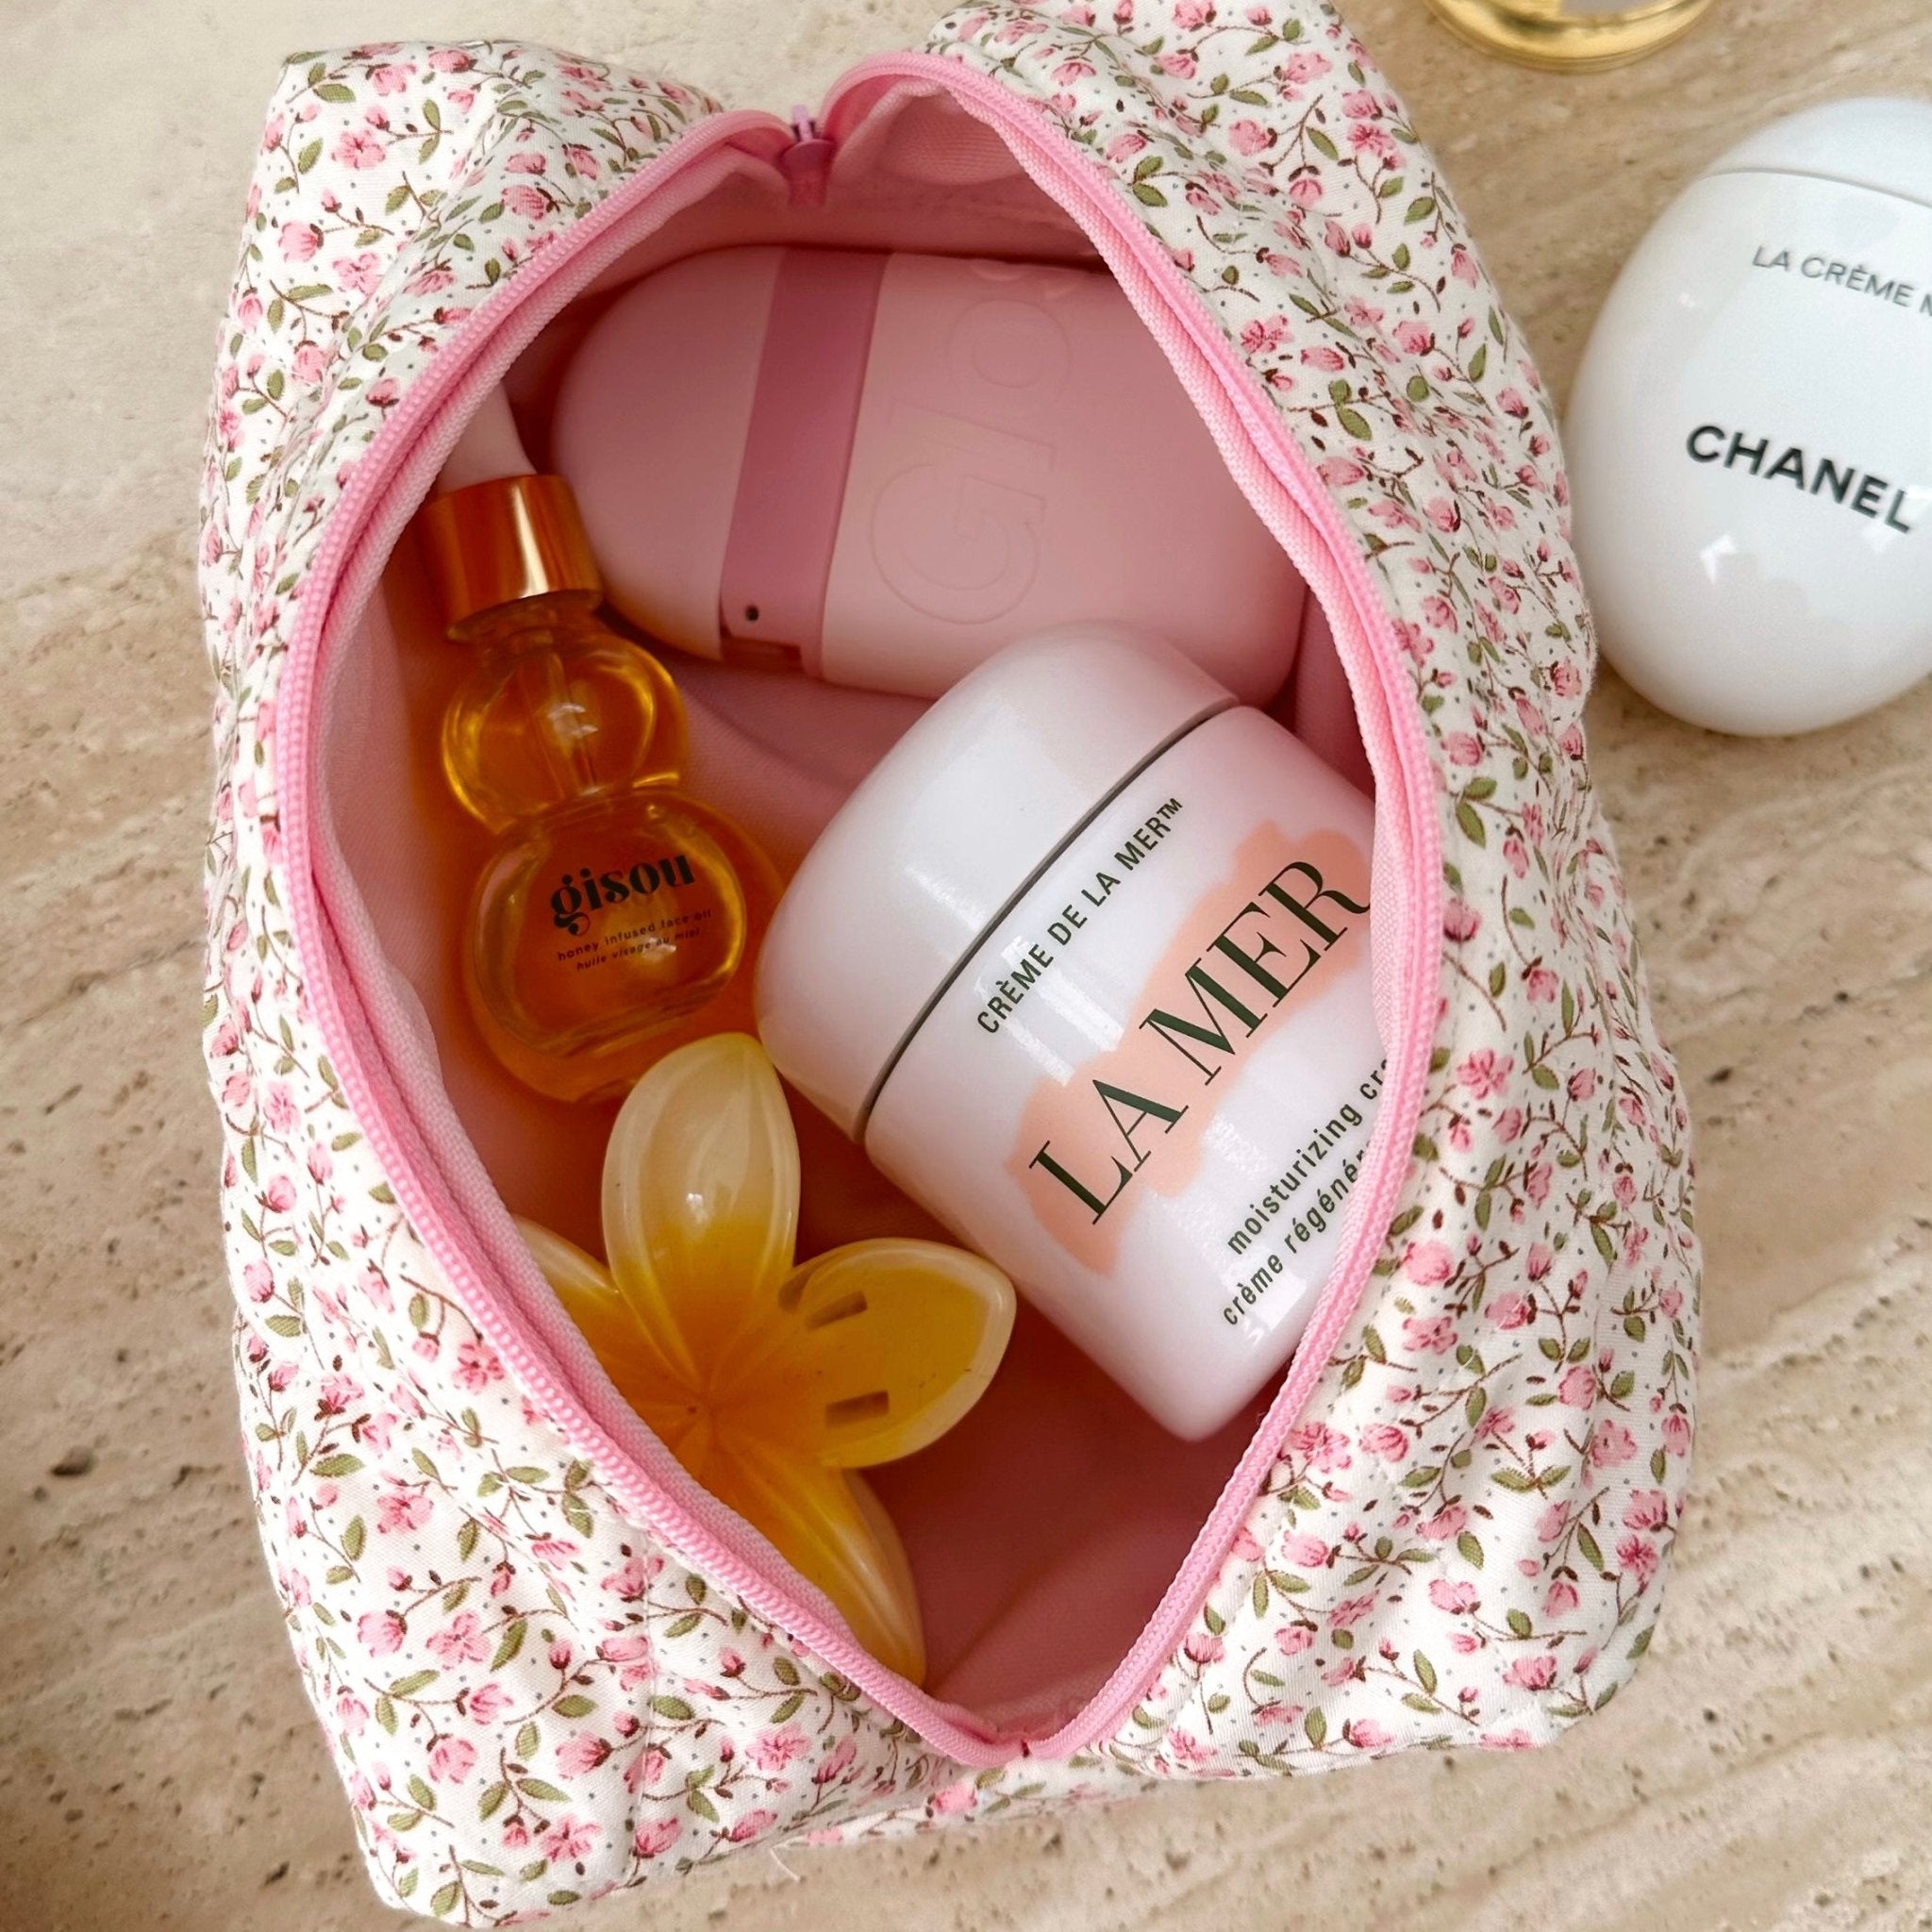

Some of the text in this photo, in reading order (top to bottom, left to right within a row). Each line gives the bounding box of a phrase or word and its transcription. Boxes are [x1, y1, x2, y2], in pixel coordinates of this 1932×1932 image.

[1752, 245, 1791, 272] LA
[1800, 257, 1915, 308] CRÈME
[1685, 425, 1911, 534] CHANEL
[550, 855, 696, 938] gisou
[558, 908, 712, 962] honey infused face oil
[576, 955, 608, 973] huile
[612, 941, 652, 959] visage
[675, 927, 700, 941] miel
[977, 943, 1054, 1034] CRÈME
[1047, 904, 1088, 946] DE
[1081, 872, 1121, 907] LA
[1028, 861, 1371, 1225] LA MER
[1224, 1140, 1371, 1325] crème régénér
[1227, 1103, 1363, 1255] moisturizing
